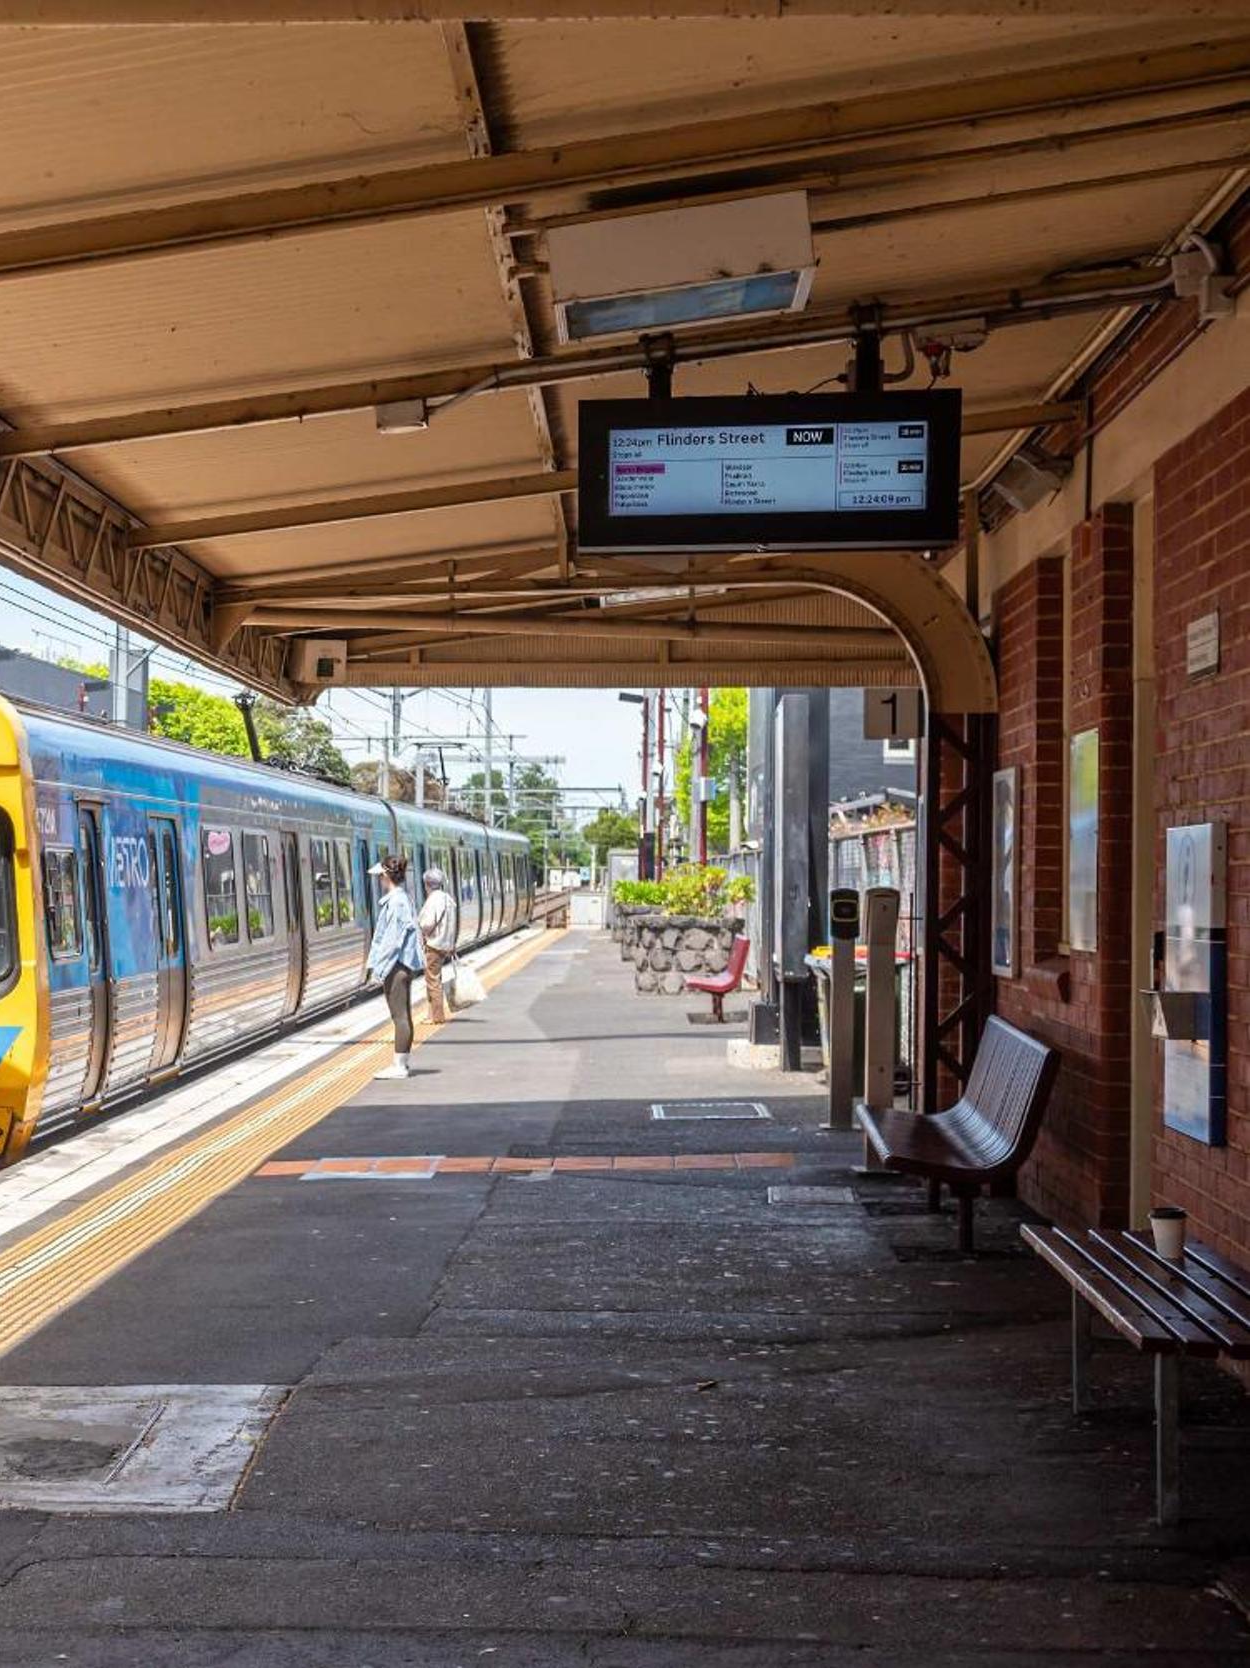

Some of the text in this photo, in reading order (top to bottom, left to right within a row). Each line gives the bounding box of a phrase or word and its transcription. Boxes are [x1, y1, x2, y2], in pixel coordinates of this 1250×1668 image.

[657, 433, 715, 446] Flinders
[719, 432, 765, 444] Street
[792, 430, 823, 443] NOW
[880, 692, 897, 736] 1
